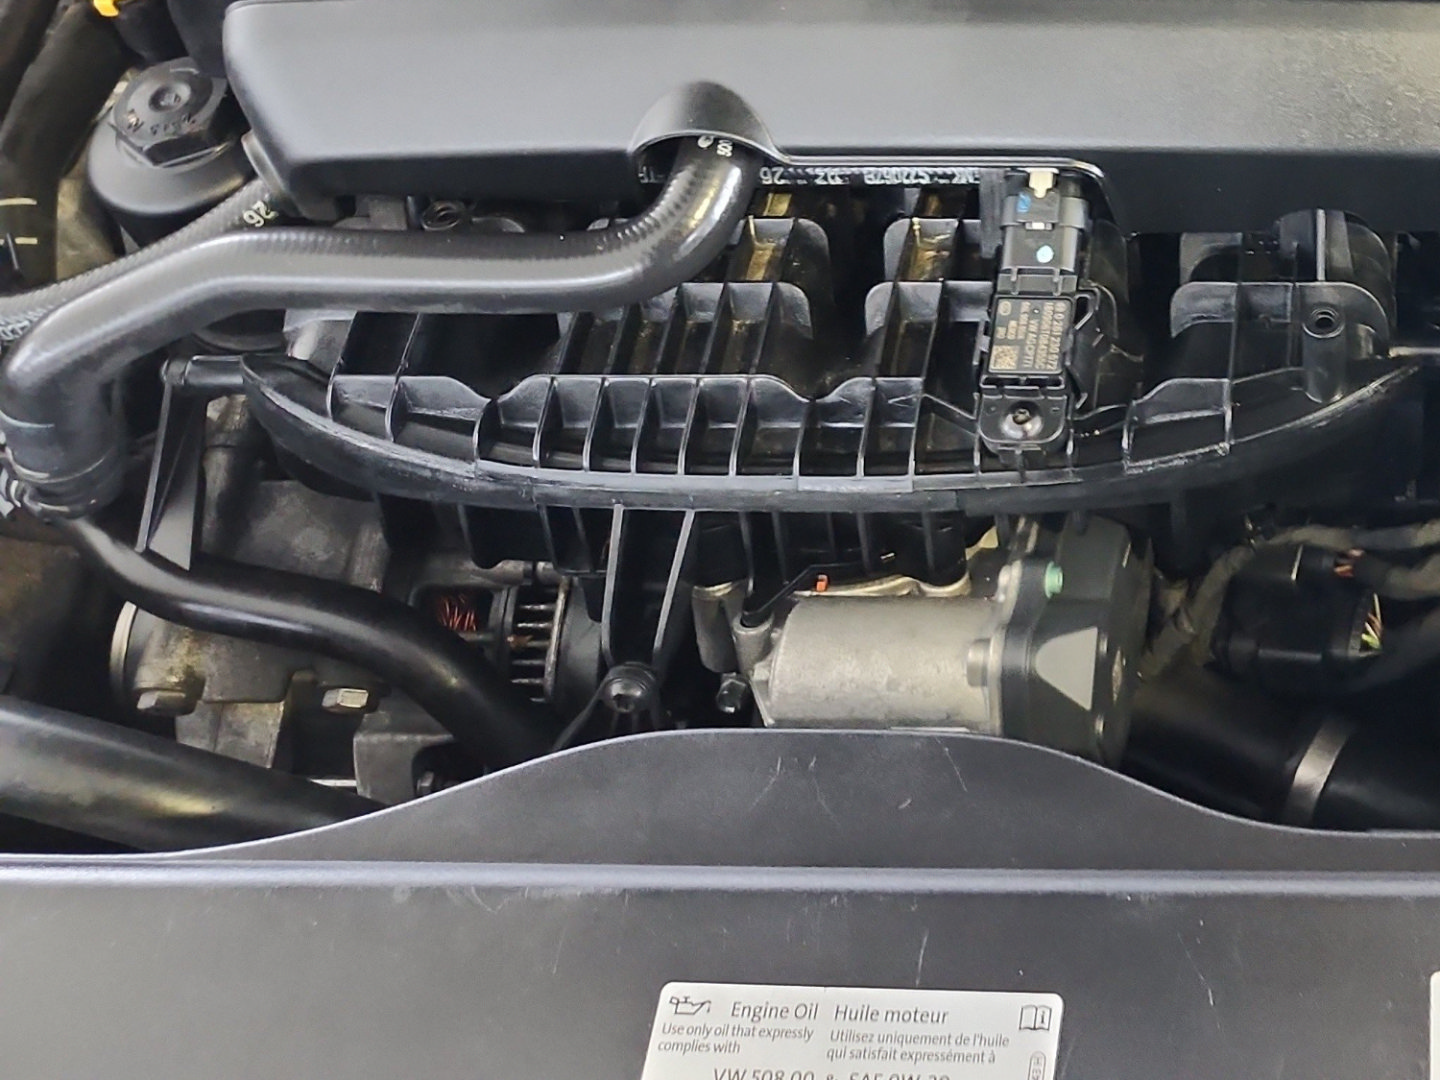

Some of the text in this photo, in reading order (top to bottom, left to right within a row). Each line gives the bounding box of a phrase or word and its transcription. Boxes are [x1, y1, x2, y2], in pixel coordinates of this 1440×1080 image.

[731, 1001, 819, 1022] Engine Oil
[834, 1004, 950, 1024] Huile moteur
[662, 1023, 815, 1042] Use only oil that expressly
[830, 1030, 1010, 1051] Utilisez uniquement de l'huile
[658, 1039, 741, 1056] complies with
[826, 1047, 847, 1061] qui
[849, 1047, 898, 1061] satisfait
[900, 1049, 982, 1065] expressément
